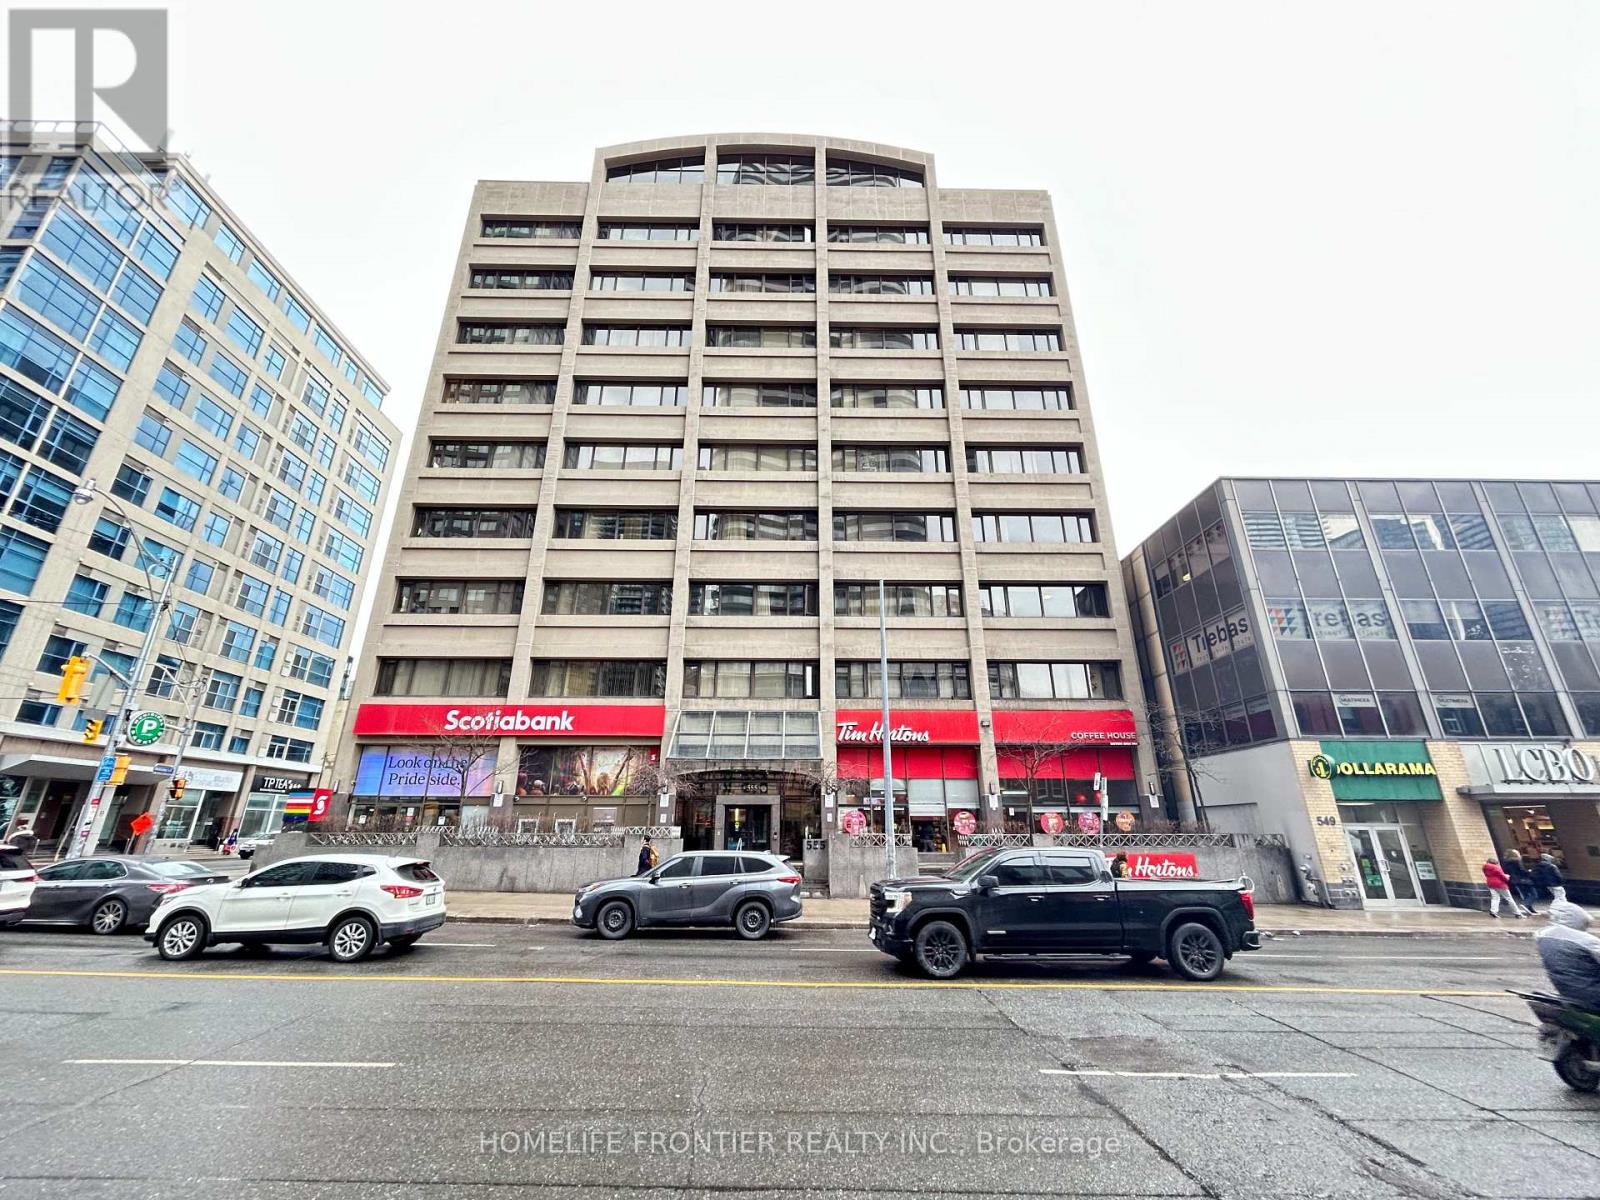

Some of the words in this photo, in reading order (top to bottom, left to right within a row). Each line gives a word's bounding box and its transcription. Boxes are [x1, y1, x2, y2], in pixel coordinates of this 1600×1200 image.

[141, 719, 158, 734] P
[443, 709, 575, 731] Scotiabank
[837, 722, 867, 742] Tim
[869, 721, 930, 742] Hrtons
[1070, 731, 1105, 739] COFFEE
[388, 756, 421, 769] Look
[1492, 748, 1594, 781] LCBO
[264, 777, 275, 788] TP
[388, 772, 425, 785] Pride
[429, 772, 460, 786] side.
[1316, 816, 1336, 826] 549
[806, 840, 826, 850] 555
[1135, 855, 1194, 877] Hortons
